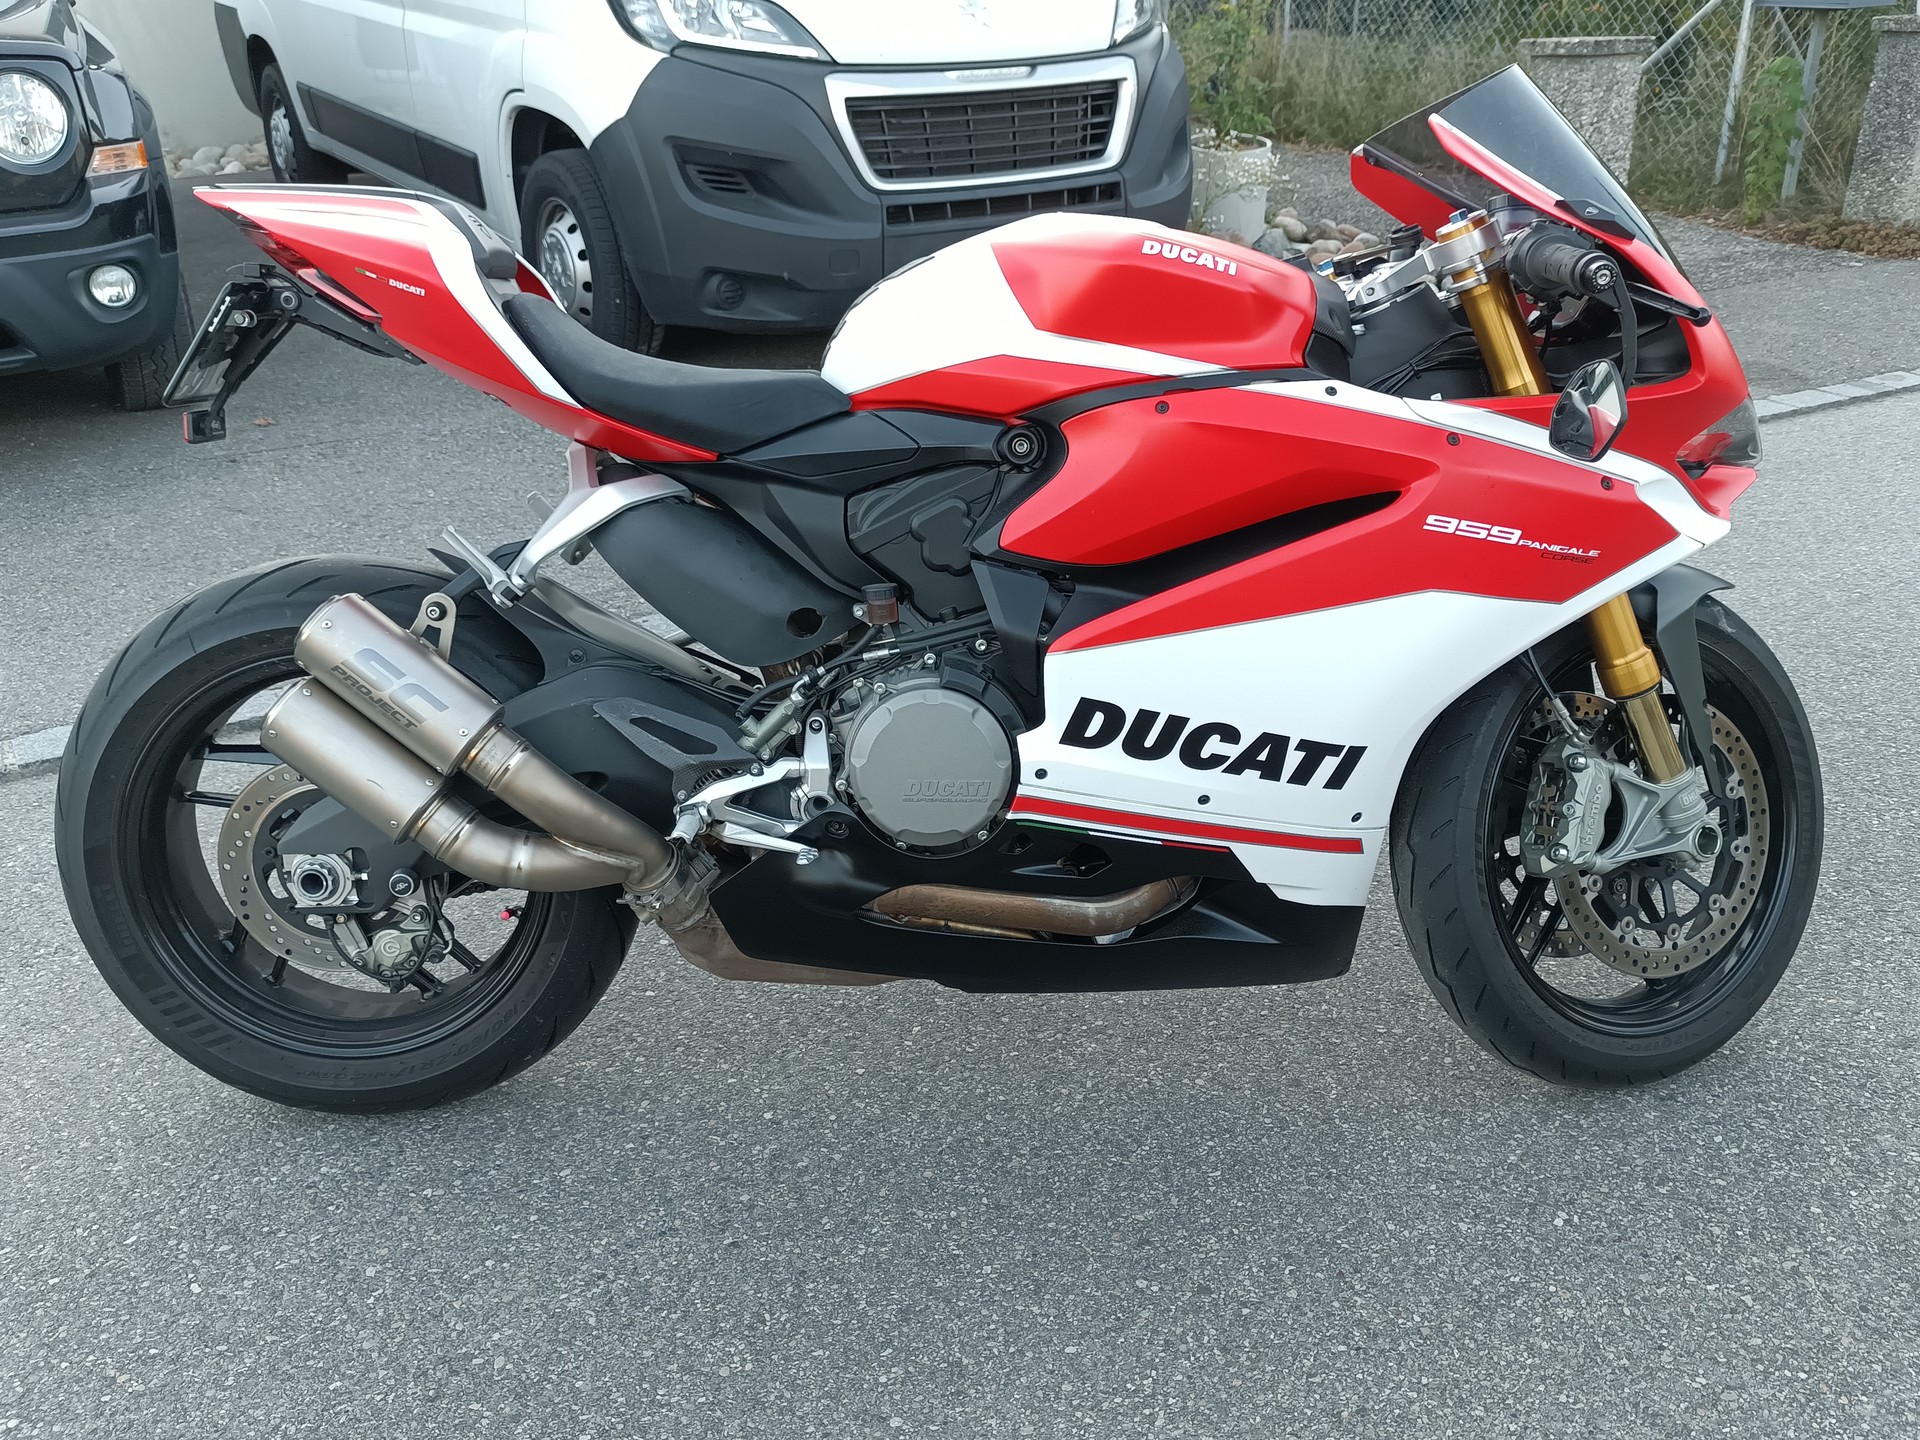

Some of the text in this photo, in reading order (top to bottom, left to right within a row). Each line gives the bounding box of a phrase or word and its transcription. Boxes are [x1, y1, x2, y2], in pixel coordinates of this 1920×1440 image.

[1141, 240, 1238, 276] DUCATI
[388, 278, 426, 297] DUCATI
[1423, 514, 1602, 558] 959 PANIGALE
[1540, 552, 1597, 565] CORSE
[329, 664, 419, 729] PROJECT
[340, 647, 450, 725] SC
[1058, 696, 1368, 790] DUCATI
[903, 780, 992, 797] DUCATI
